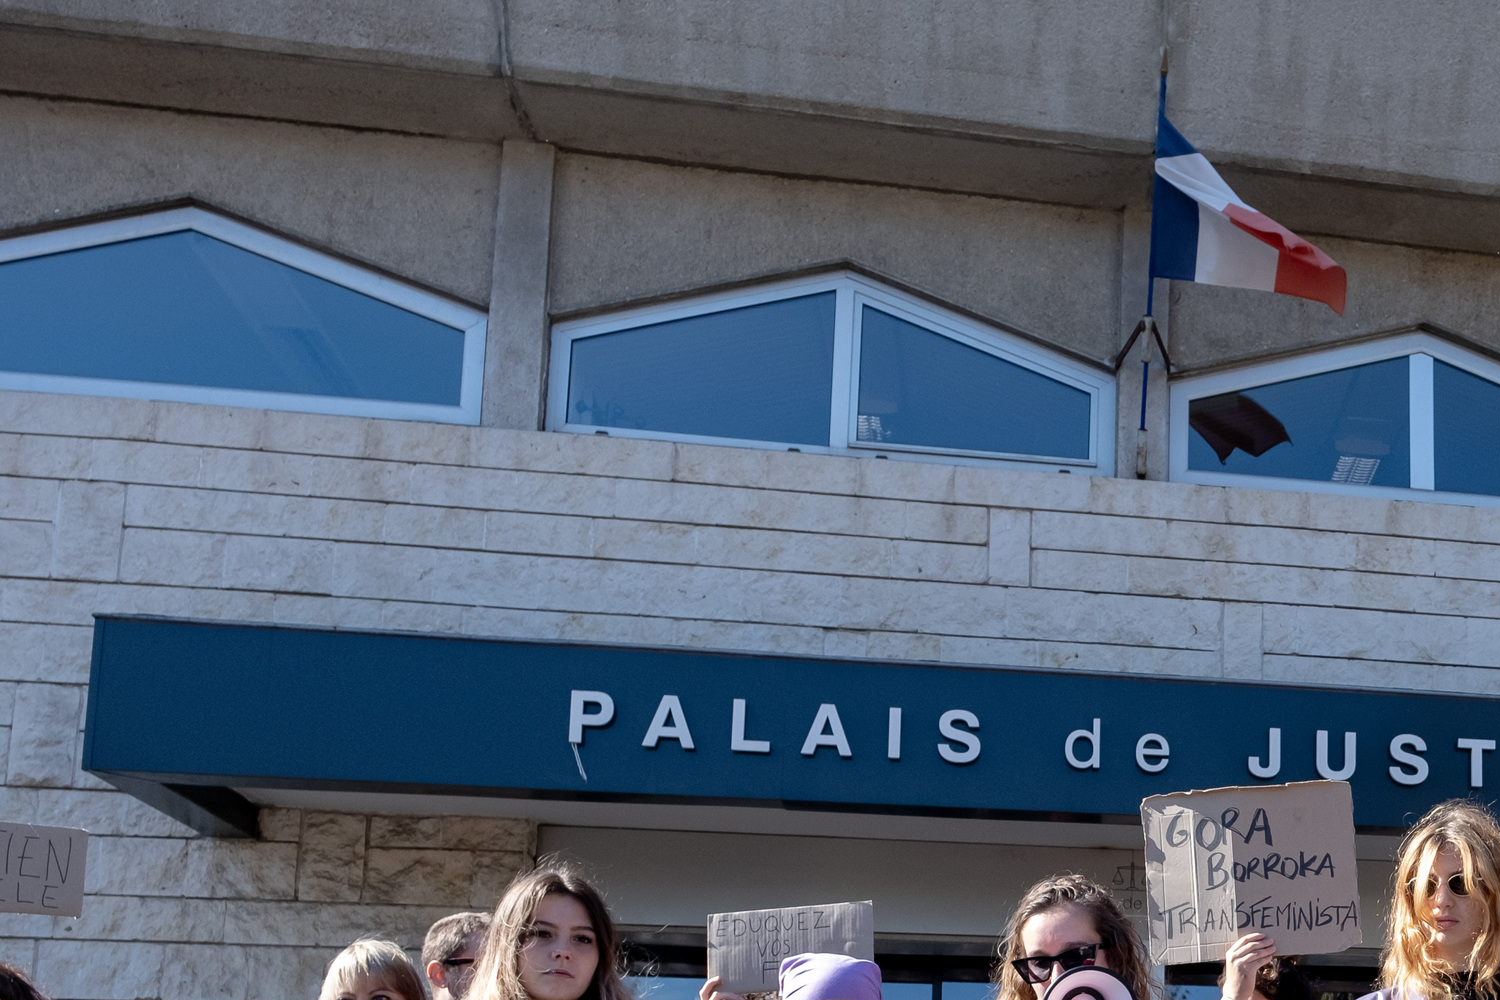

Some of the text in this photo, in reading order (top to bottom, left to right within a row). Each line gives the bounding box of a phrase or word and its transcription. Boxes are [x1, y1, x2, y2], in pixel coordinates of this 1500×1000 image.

[568, 690, 982, 764] PALAIS
[1064, 718, 1171, 773] de
[1164, 806, 1274, 852] GORA
[0, 829, 73, 885] IEN
[1204, 850, 1336, 891] BORROKA
[0, 878, 59, 910] LE
[716, 911, 831, 938] EDUQUEZ
[757, 938, 791, 958] VOS
